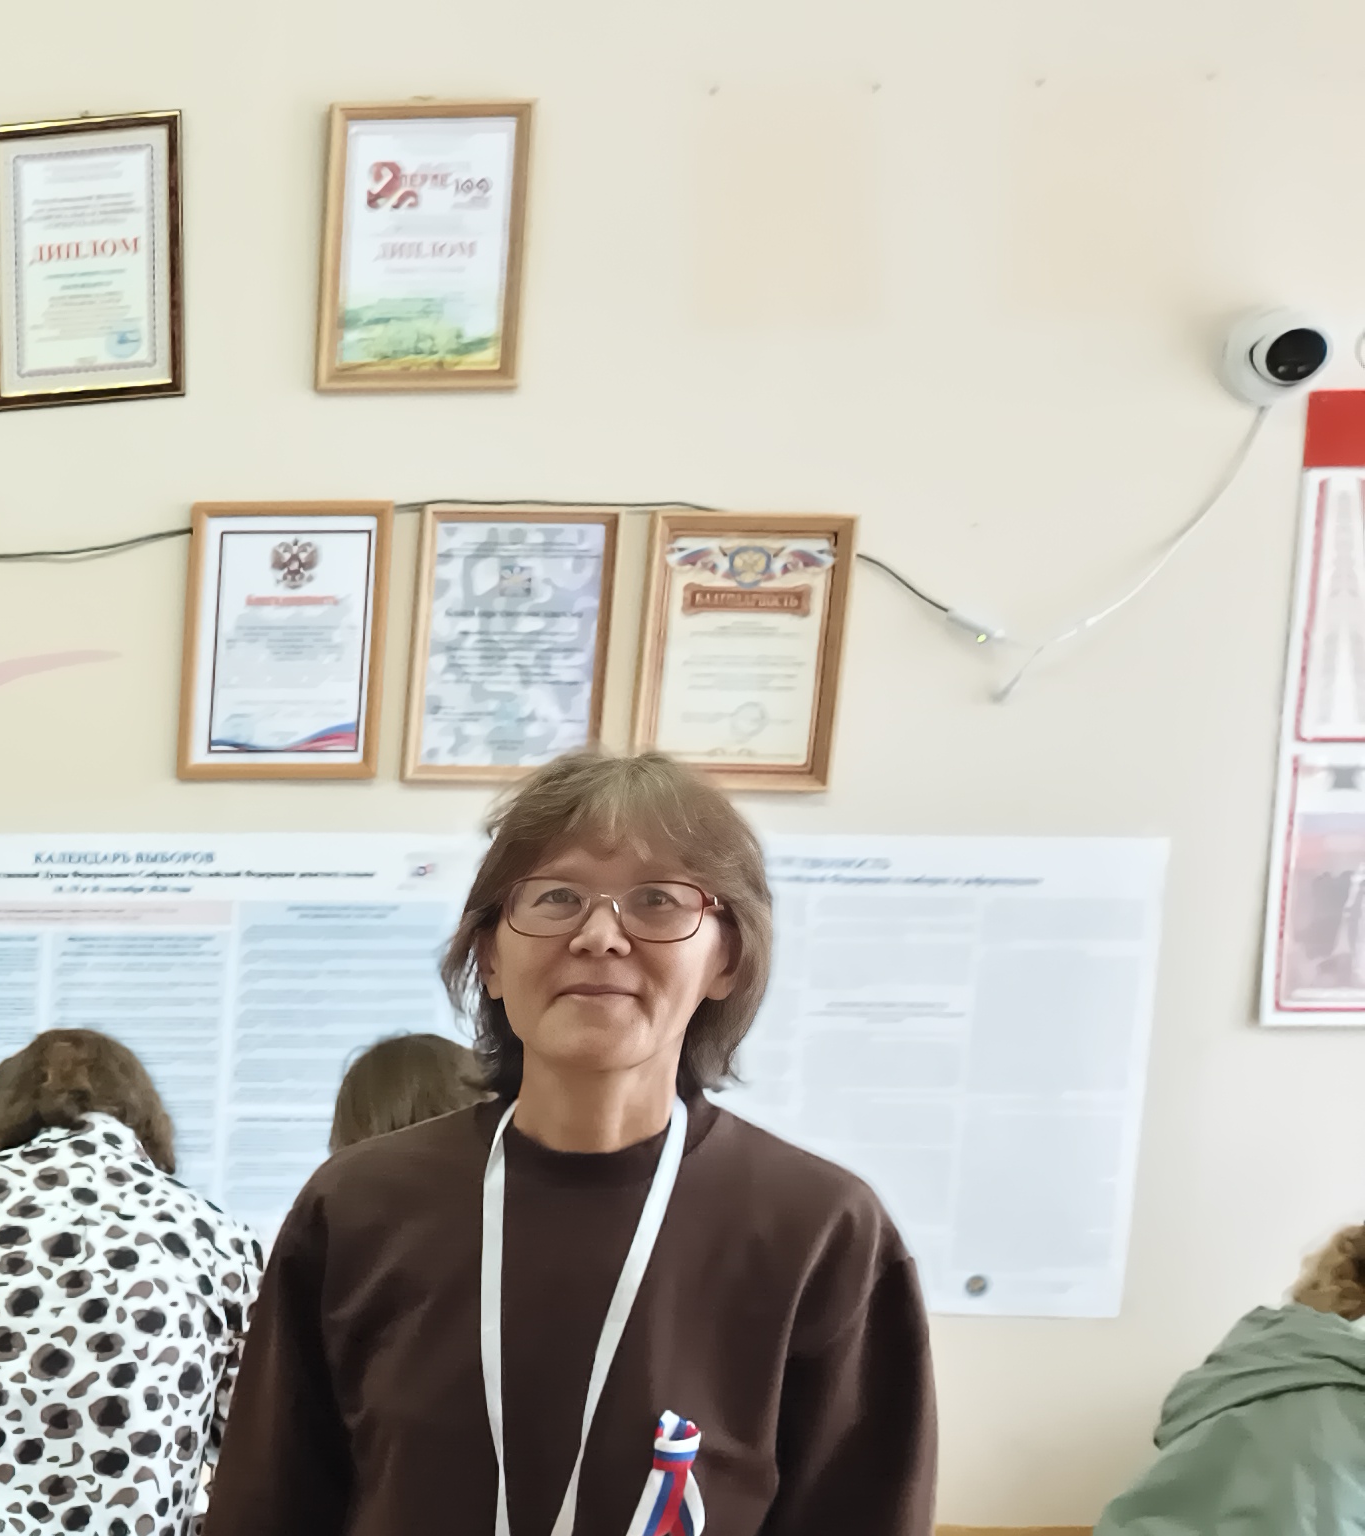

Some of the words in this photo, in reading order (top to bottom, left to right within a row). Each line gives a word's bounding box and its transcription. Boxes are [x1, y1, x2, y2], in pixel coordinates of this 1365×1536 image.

[30, 238, 139, 263] ДИПЛОМ
[34, 851, 131, 864] КАЛЕНДАРЬ
[136, 851, 215, 864] ВЫБОРОВ
